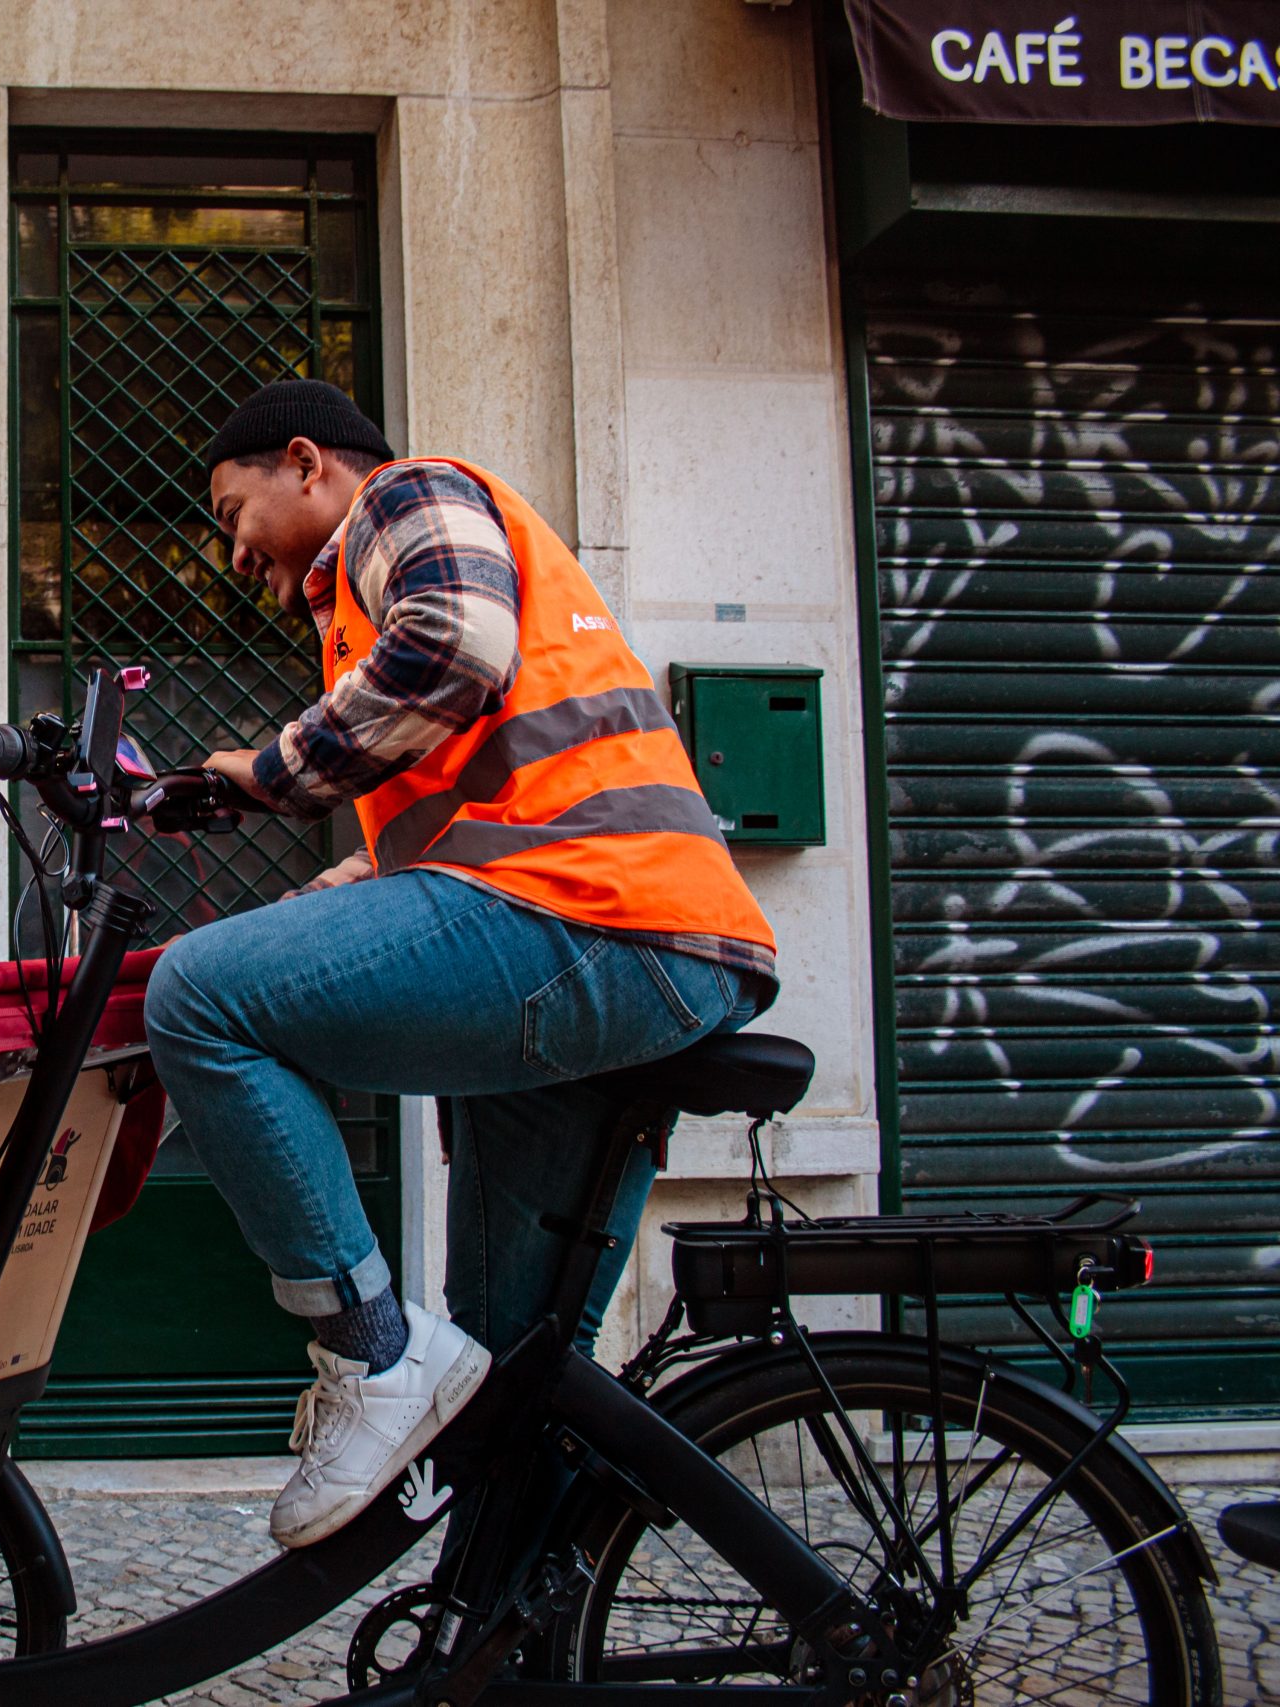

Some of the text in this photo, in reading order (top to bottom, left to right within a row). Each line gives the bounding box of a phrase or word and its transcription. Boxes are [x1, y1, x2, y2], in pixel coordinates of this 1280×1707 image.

[931, 17, 1280, 91] CAFÉ BECA
[23, 1219, 56, 1238] IDADE
